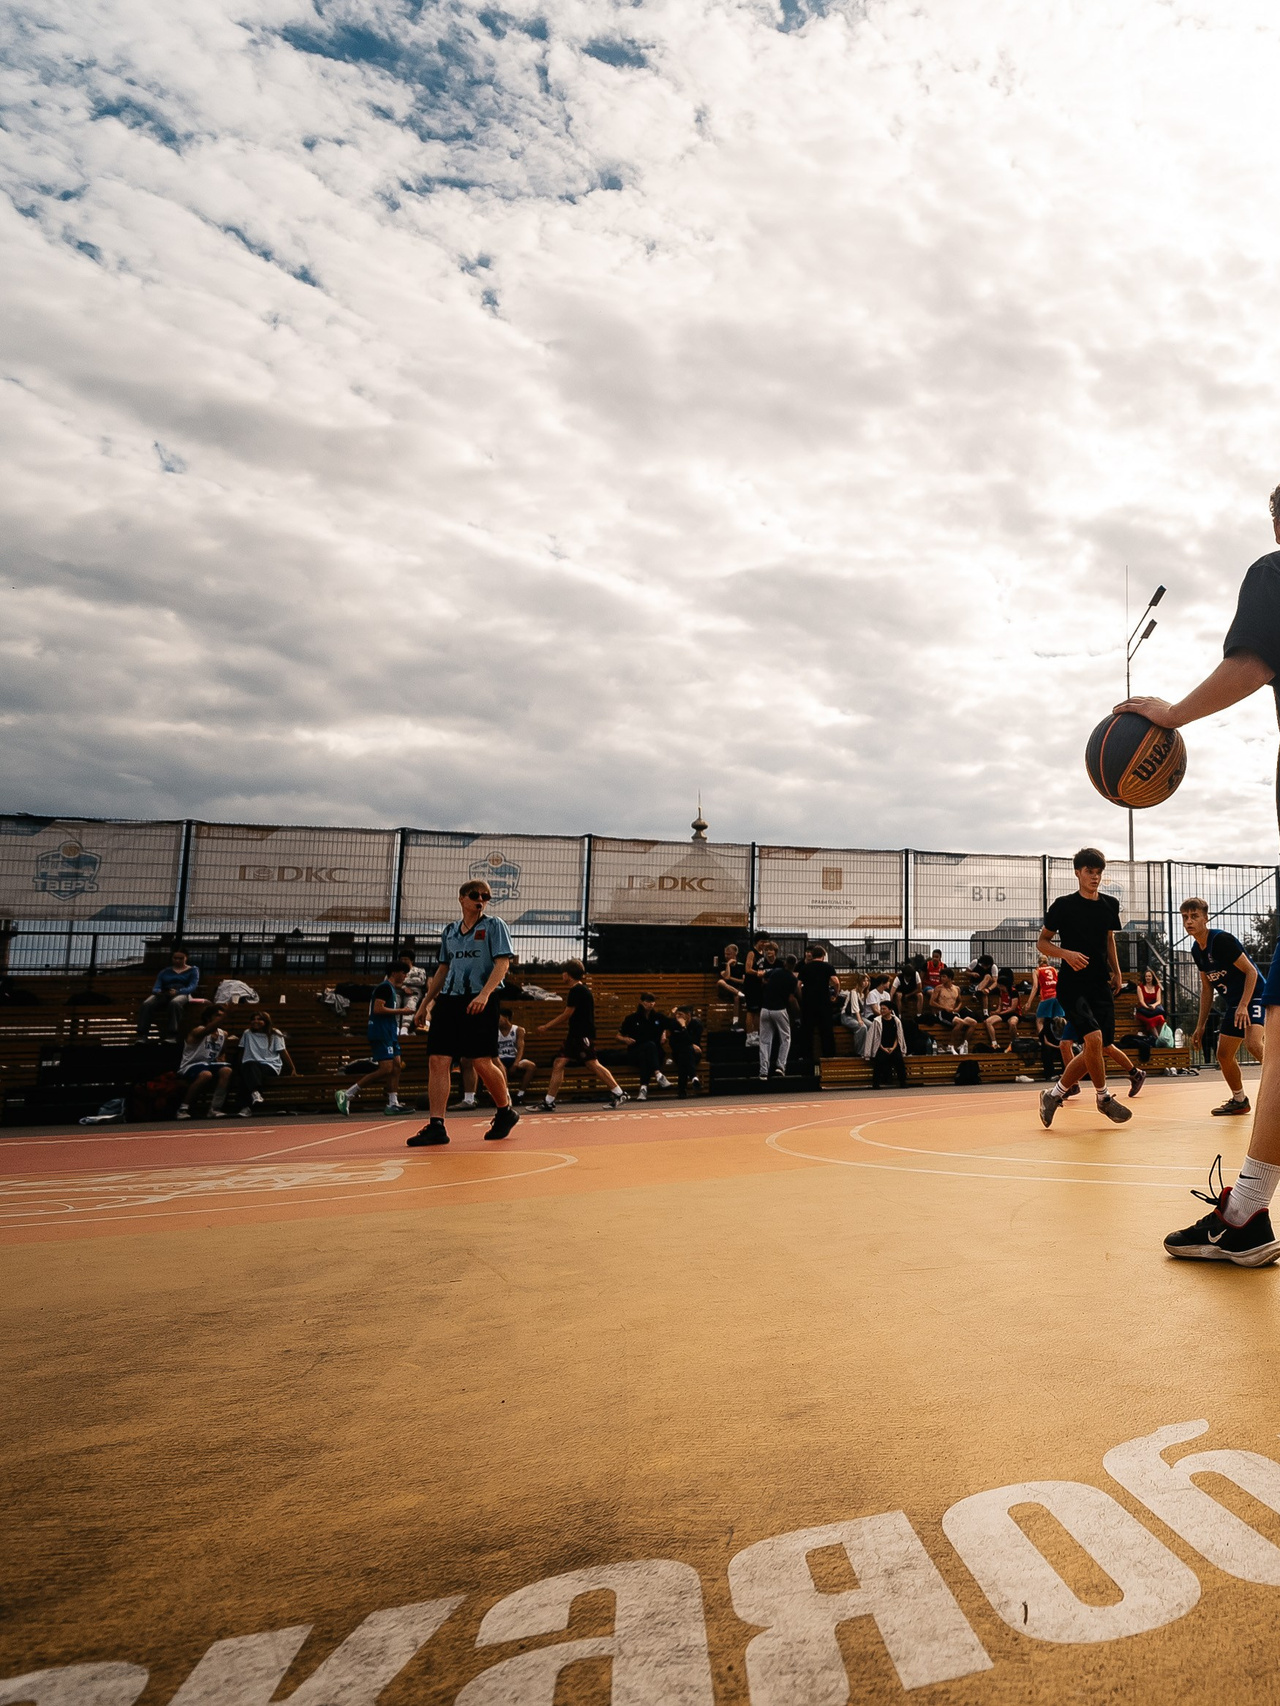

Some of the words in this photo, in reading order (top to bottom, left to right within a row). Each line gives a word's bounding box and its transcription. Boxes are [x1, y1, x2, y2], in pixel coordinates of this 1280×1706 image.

[1132, 729, 1176, 781] Wilso
[34, 879, 98, 892] ТВЕРЬ
[658, 876, 715, 892] DKC
[491, 888, 520, 899] ЕРЬ
[972, 886, 1006, 902] ВТБ
[455, 950, 481, 959] DKC
[1206, 970, 1228, 982] ЕРЬ
[1252, 1005, 1262, 1018] 3
